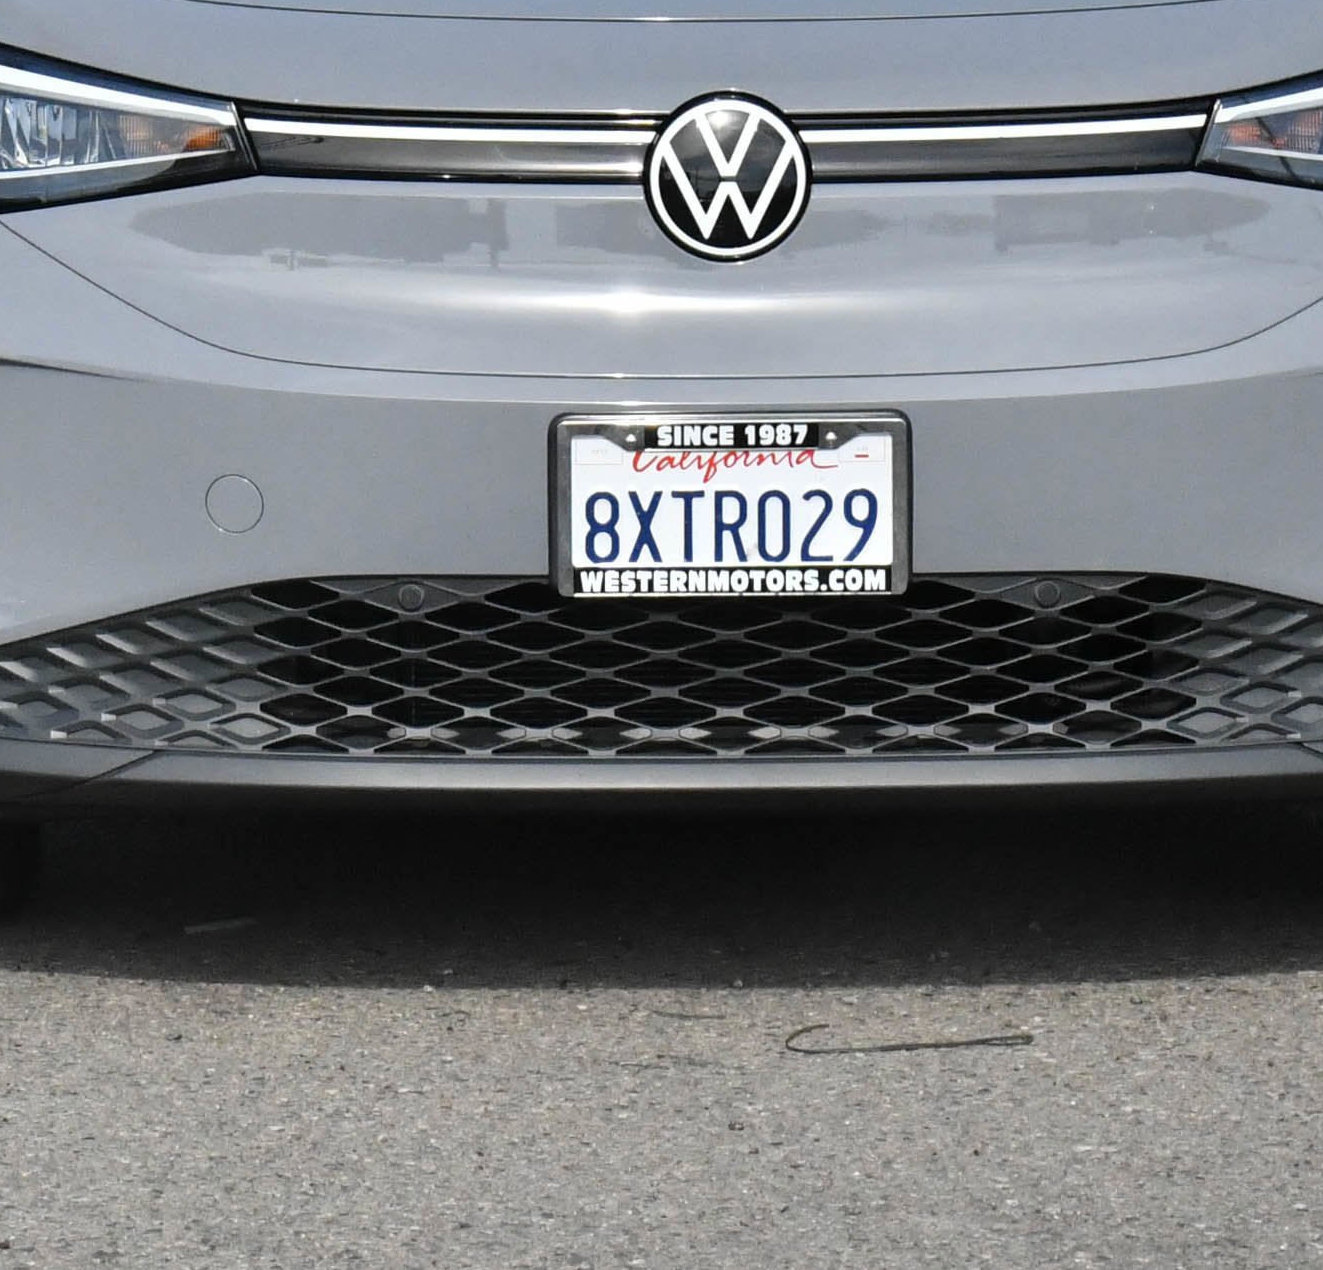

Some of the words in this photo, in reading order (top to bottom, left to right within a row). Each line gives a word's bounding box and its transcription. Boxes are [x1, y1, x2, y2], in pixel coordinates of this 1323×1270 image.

[656, 424, 735, 447] SINCE
[744, 423, 809, 447] 1987
[632, 448, 839, 484] California
[584, 488, 879, 564] 8XTR029
[579, 568, 887, 593] WESTERNMOTORS.COM
